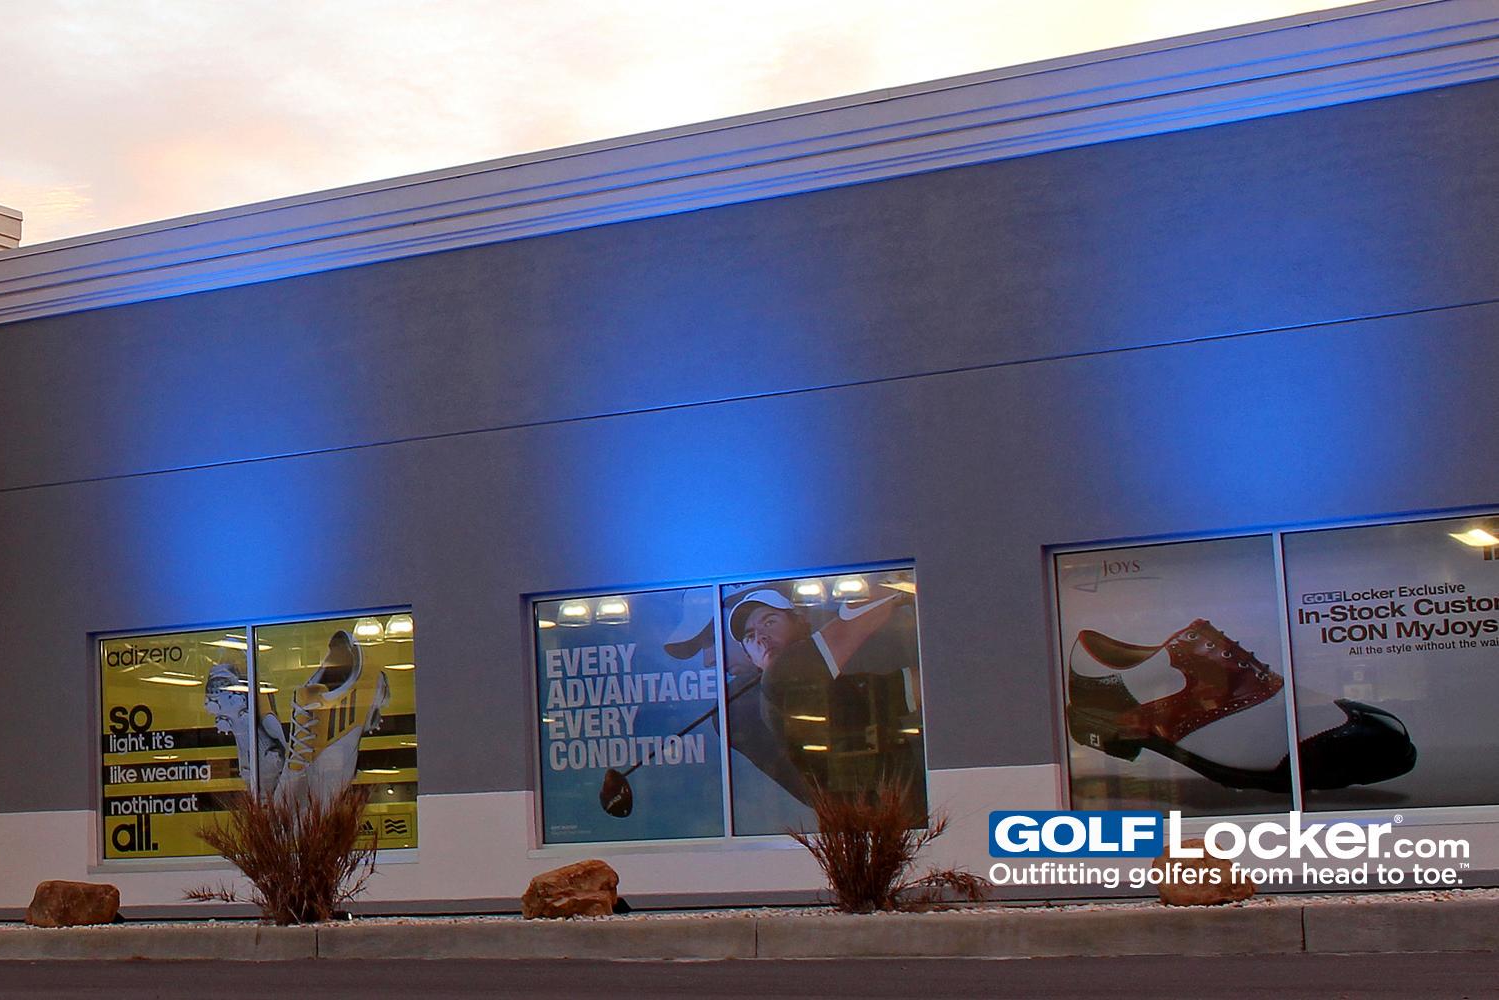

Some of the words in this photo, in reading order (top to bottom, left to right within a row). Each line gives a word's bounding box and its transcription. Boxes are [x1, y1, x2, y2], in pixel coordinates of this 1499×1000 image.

[1398, 582, 1466, 598] Exclusive
[1298, 601, 1407, 625] In-Stock
[1413, 595, 1499, 617] Custo
[1321, 623, 1388, 643] ICON
[1395, 619, 1499, 641] MyJoys
[107, 645, 182, 667] adizero
[545, 642, 637, 679] EVERY
[1349, 646, 1362, 656] All
[1366, 644, 1383, 655] the
[1386, 643, 1412, 654] style
[1415, 640, 1456, 652] without
[1459, 639, 1477, 650] the
[546, 669, 717, 710] ADVANTAGE
[109, 704, 153, 734] so
[548, 705, 640, 741] EVERY
[152, 731, 175, 750] it's
[549, 734, 706, 771] CONDITION
[109, 765, 138, 784] like
[141, 762, 211, 782] wearing
[110, 796, 176, 816] nothing
[179, 794, 199, 812] at
[111, 814, 159, 852] all.
